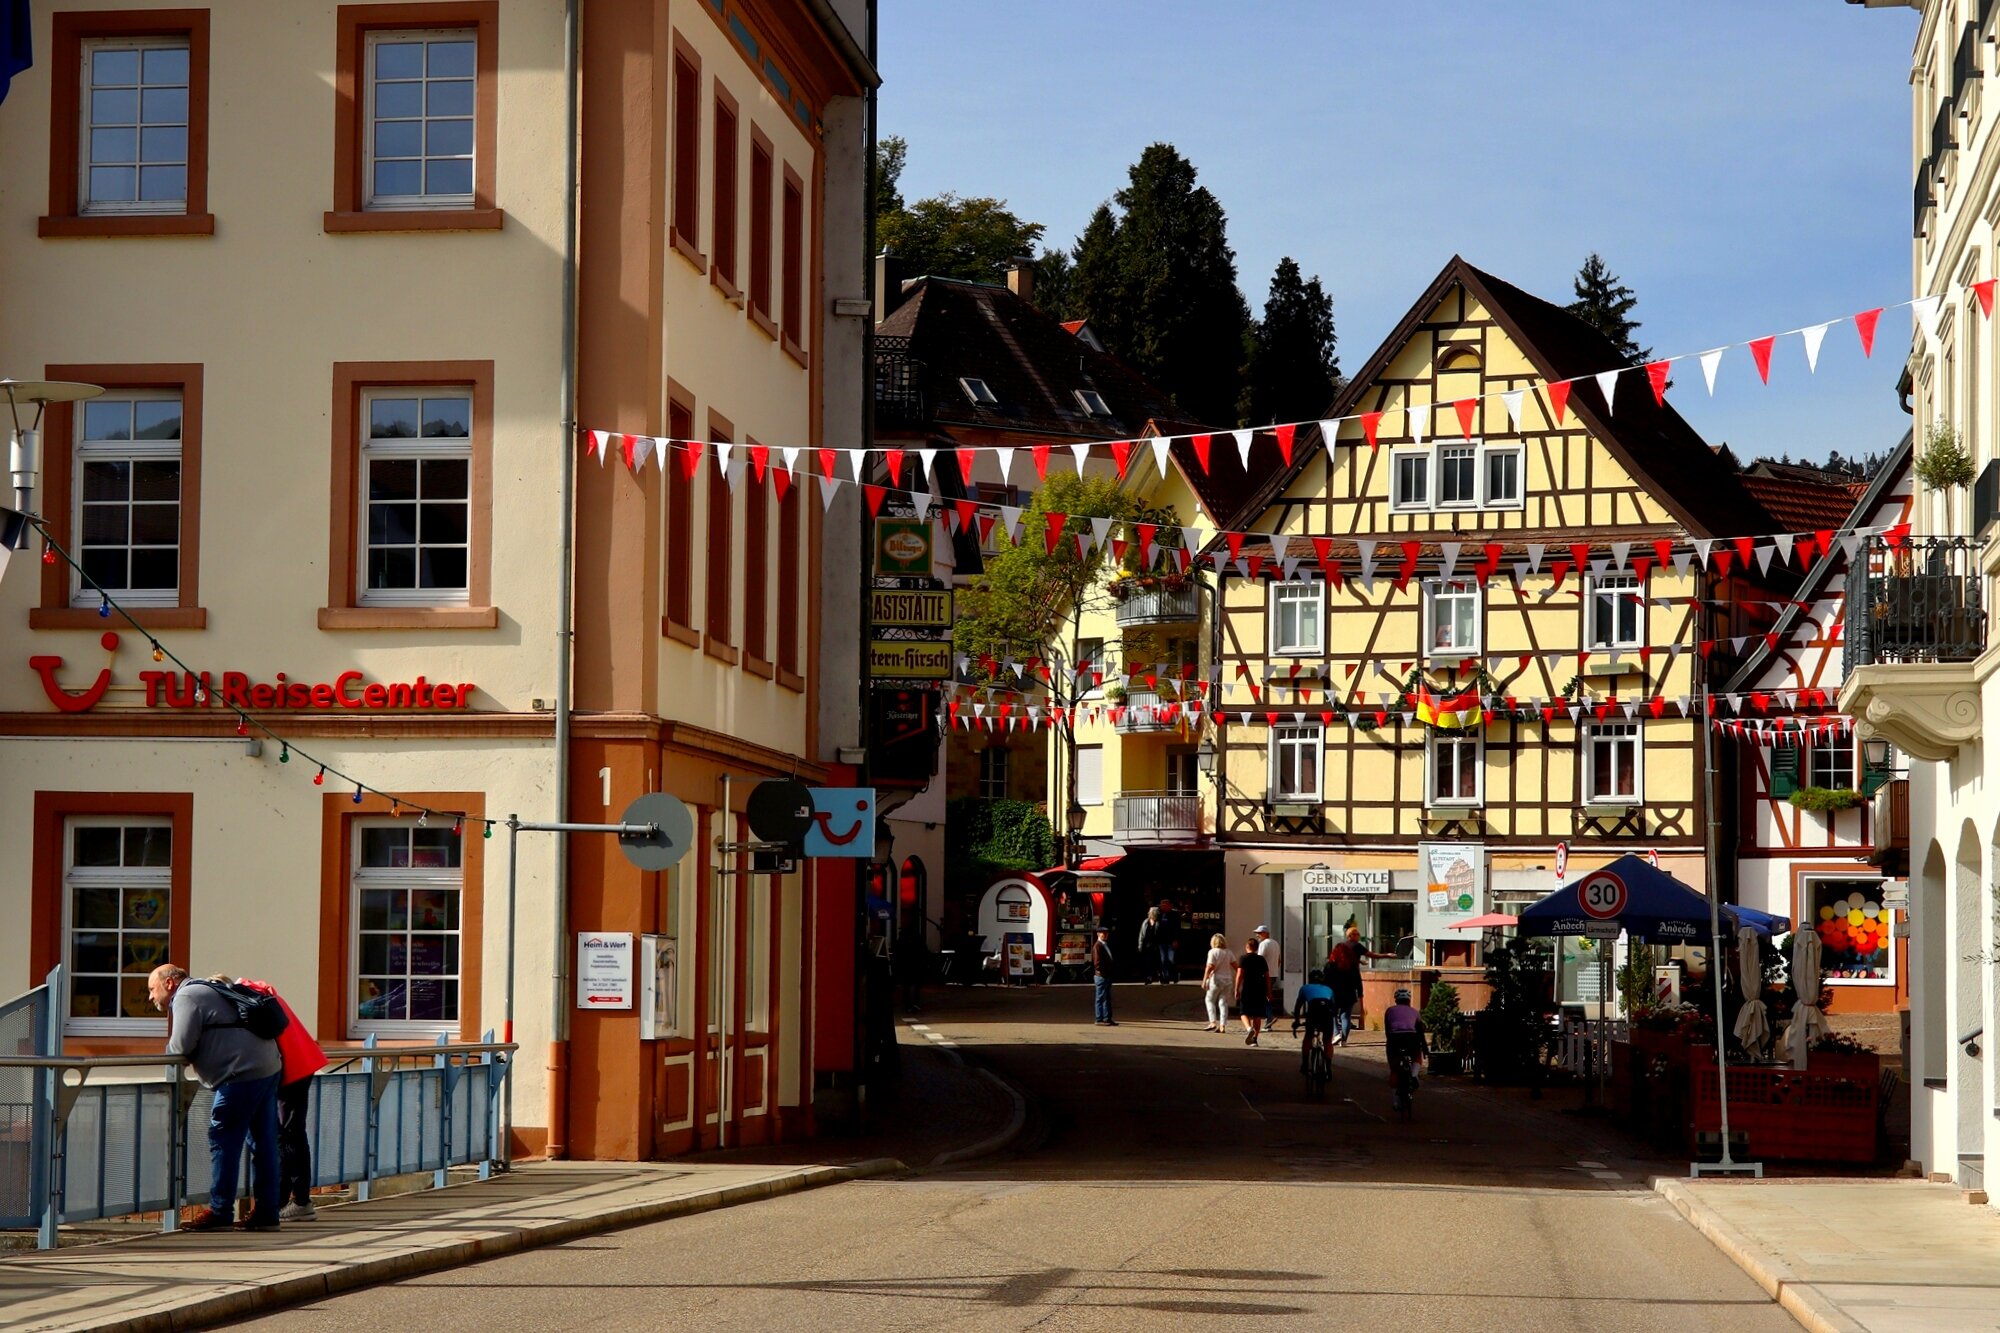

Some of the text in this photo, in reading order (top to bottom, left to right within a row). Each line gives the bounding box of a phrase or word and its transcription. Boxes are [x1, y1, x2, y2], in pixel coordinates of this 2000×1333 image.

[873, 593, 944, 621] ASTSTÄTTE
[870, 648, 948, 670] tern-Hirsch
[139, 671, 475, 709] TUI ReiseCenter
[598, 767, 611, 806] 1
[1240, 864, 1247, 875] 7
[1589, 884, 1616, 906] 30
[1552, 919, 1585, 931] Andech
[1658, 921, 1697, 934] Andechs
